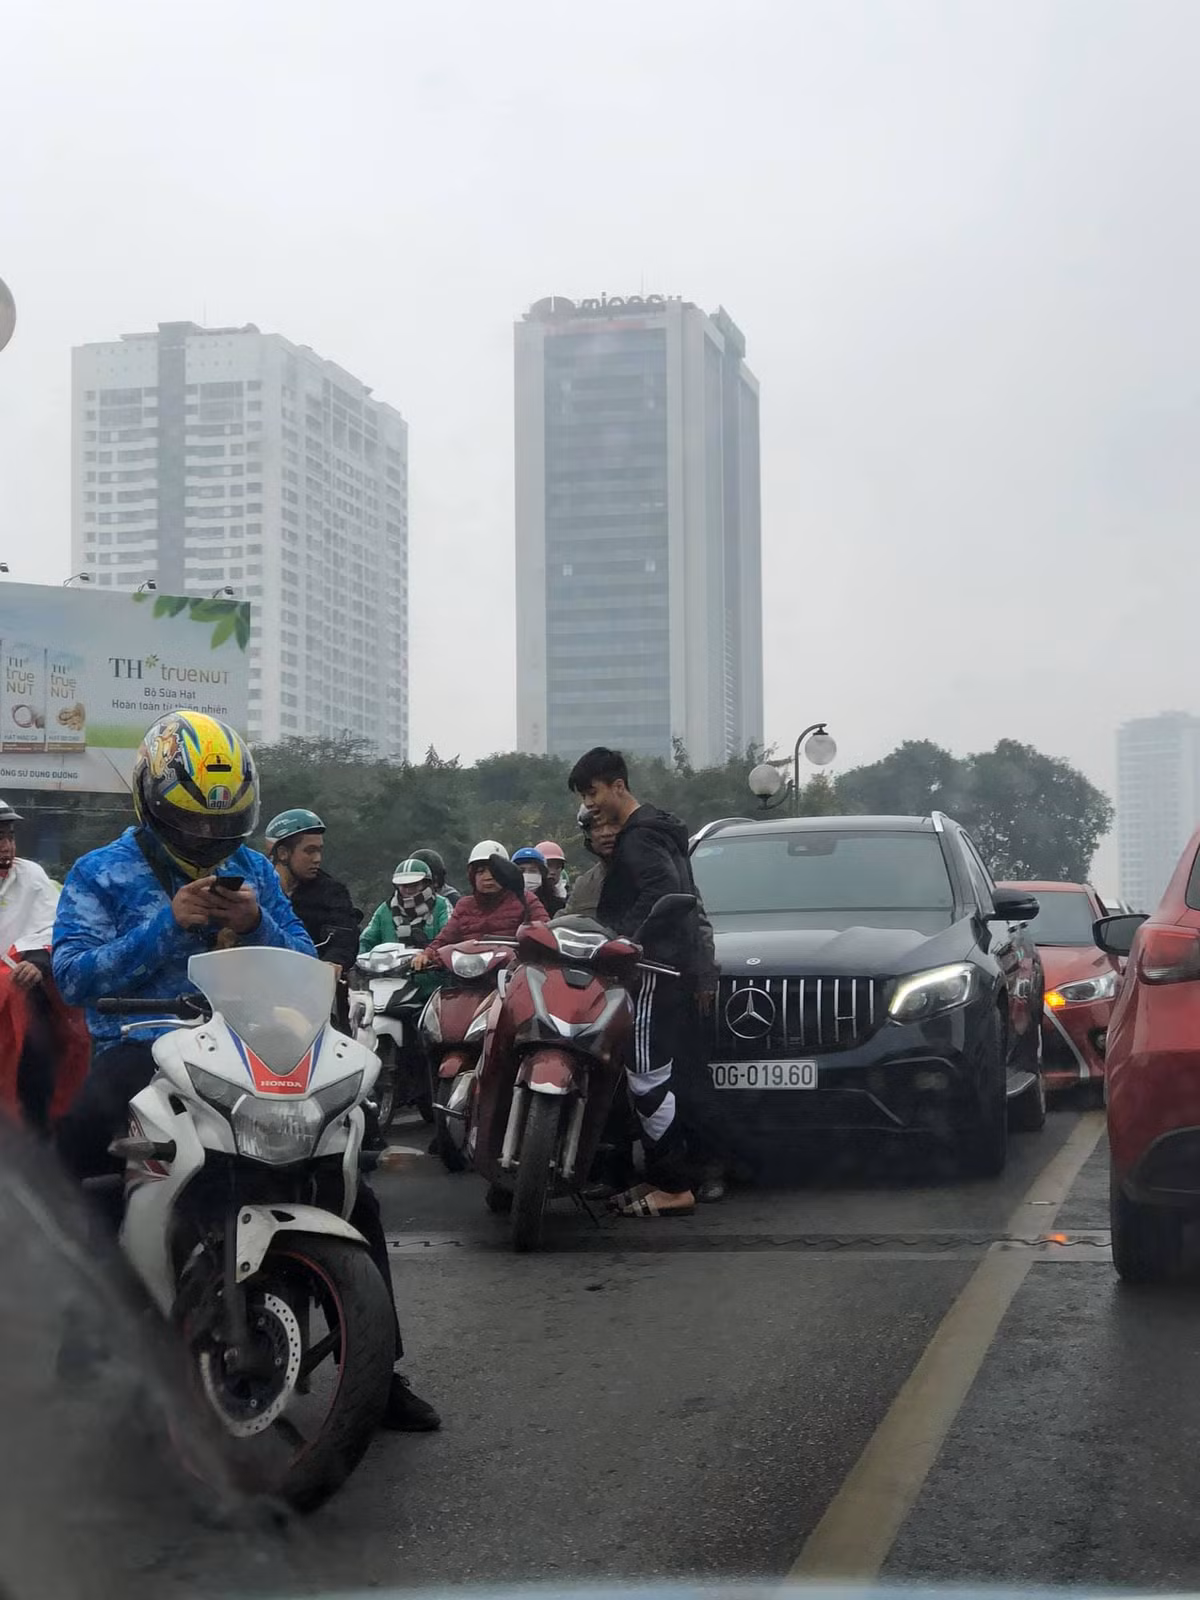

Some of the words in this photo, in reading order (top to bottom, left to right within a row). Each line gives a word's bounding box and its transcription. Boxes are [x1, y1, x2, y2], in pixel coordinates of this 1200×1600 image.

[6, 666, 35, 682] true
[108, 657, 144, 680] TH
[51, 673, 76, 688] true
[6, 681, 35, 696] NUT
[50, 687, 76, 700] NUT
[260, 1080, 303, 1088] HONDA
